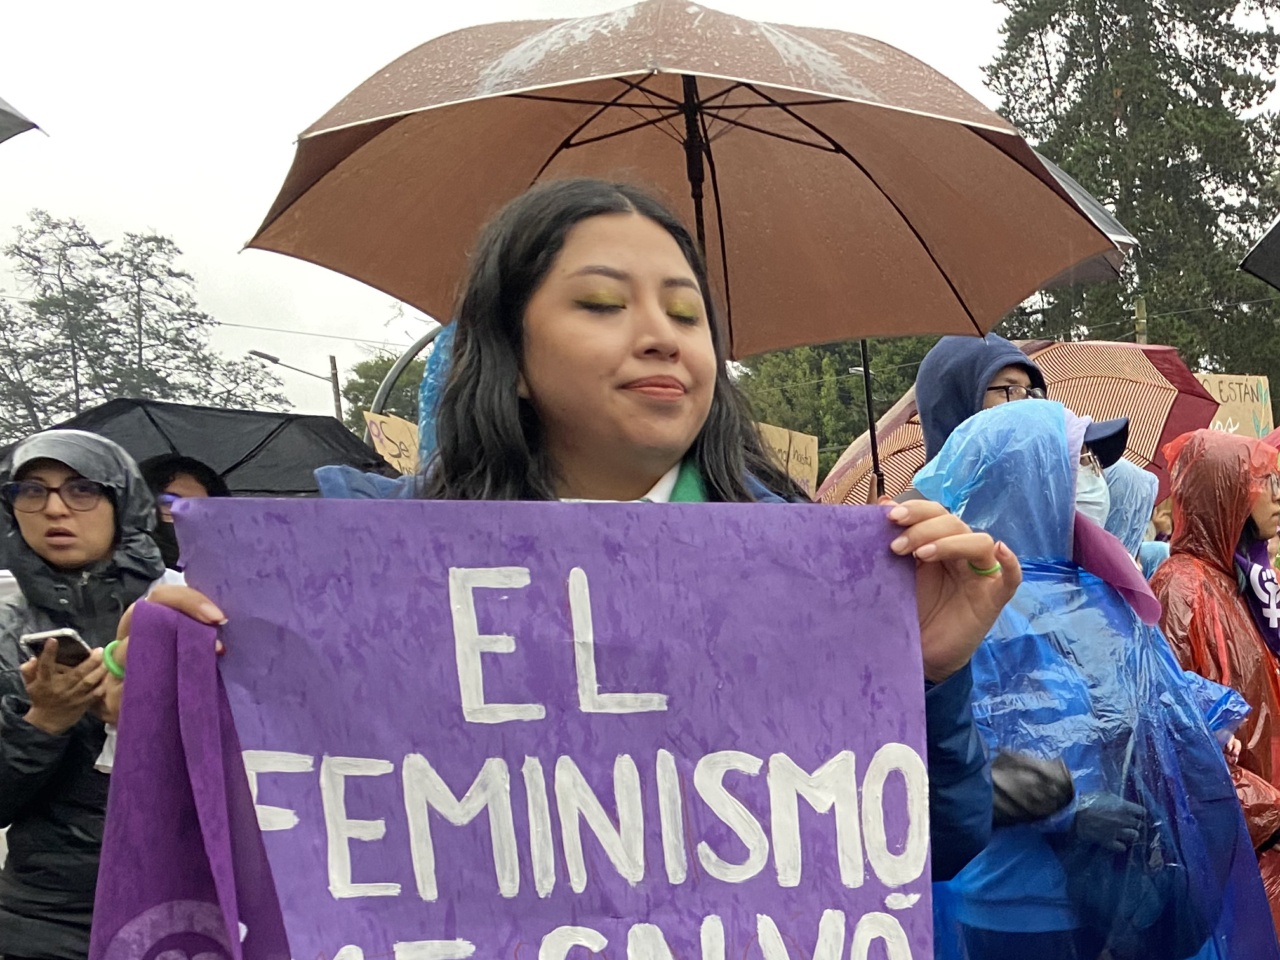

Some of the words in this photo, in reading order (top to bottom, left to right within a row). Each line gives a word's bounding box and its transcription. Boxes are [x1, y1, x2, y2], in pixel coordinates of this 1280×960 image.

[379, 420, 411, 459] Se
[1218, 379, 1259, 404] ESTÁN
[449, 566, 669, 724] EL
[243, 742, 930, 901] FEMINISMO
